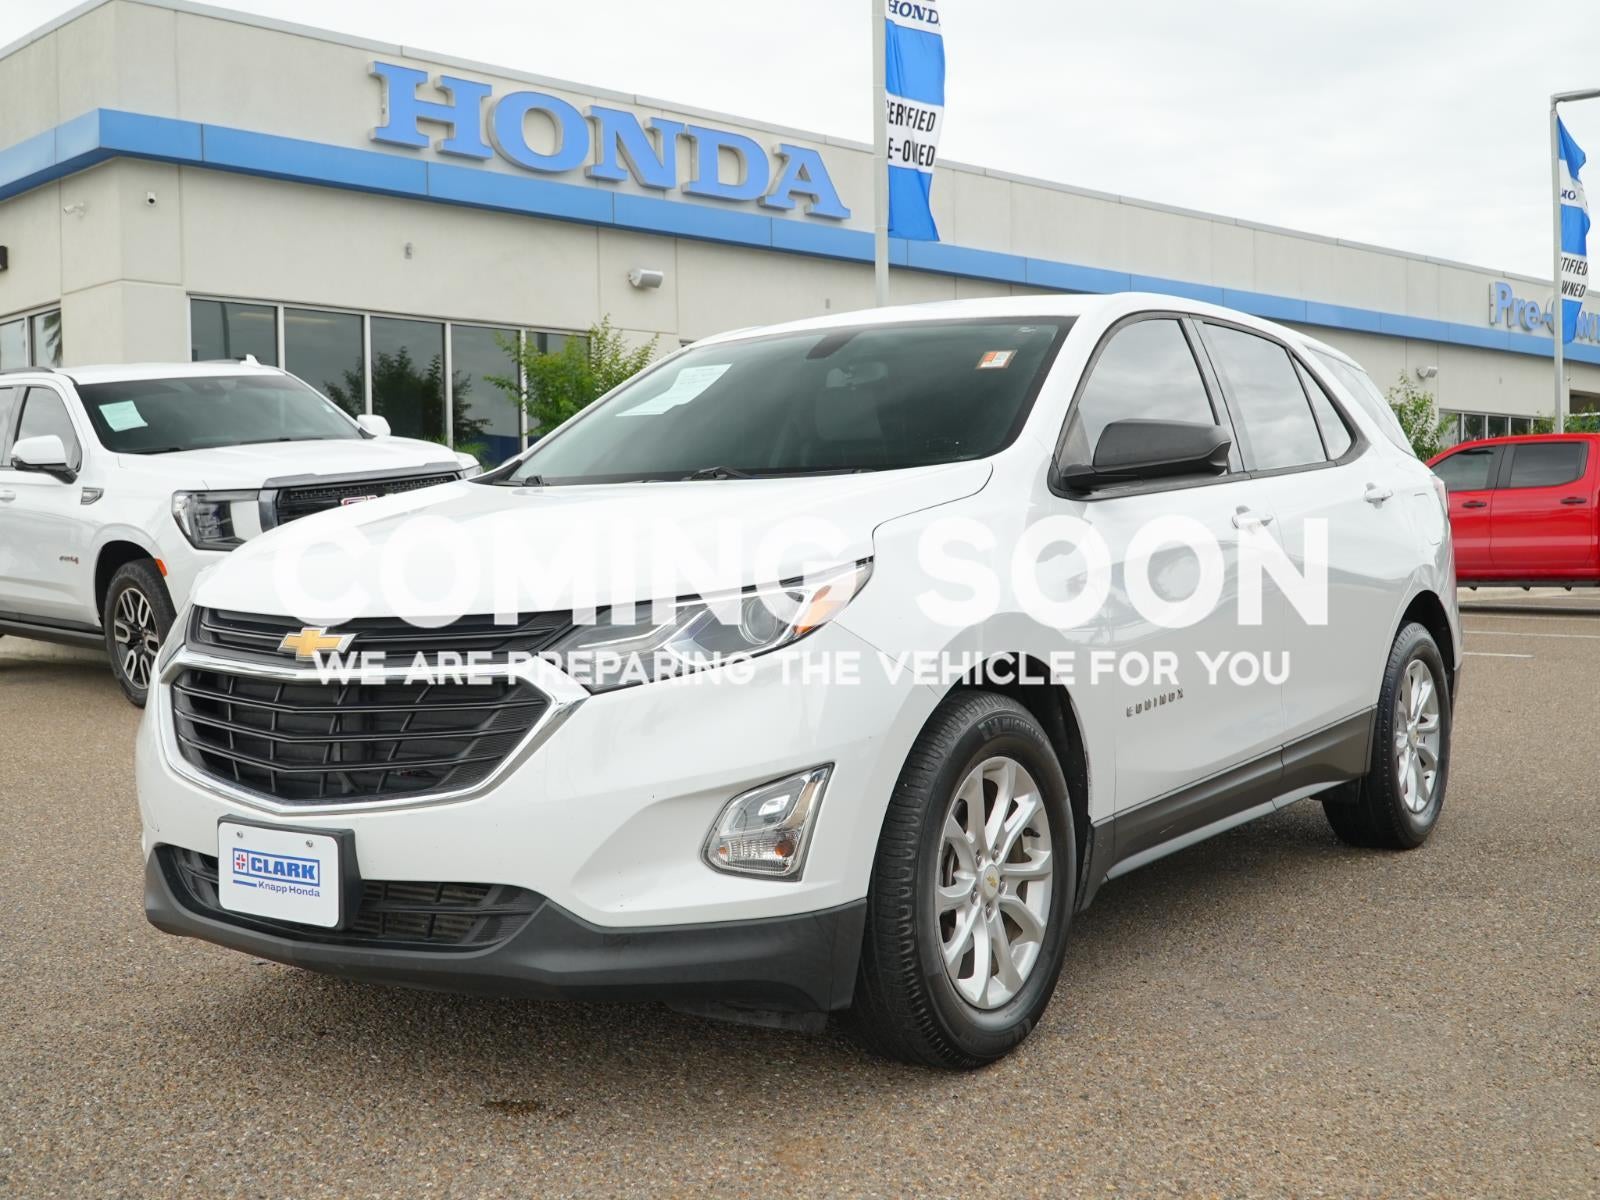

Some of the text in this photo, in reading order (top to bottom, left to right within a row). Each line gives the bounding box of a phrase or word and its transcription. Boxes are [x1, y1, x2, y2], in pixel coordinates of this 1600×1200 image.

[889, 0, 941, 27] HOND
[369, 60, 851, 220] HONDA
[1560, 256, 1588, 276] TIFIED
[1561, 279, 1587, 298] WNED
[251, 857, 315, 880] CLARK
[259, 881, 320, 897] Knapp Honda
